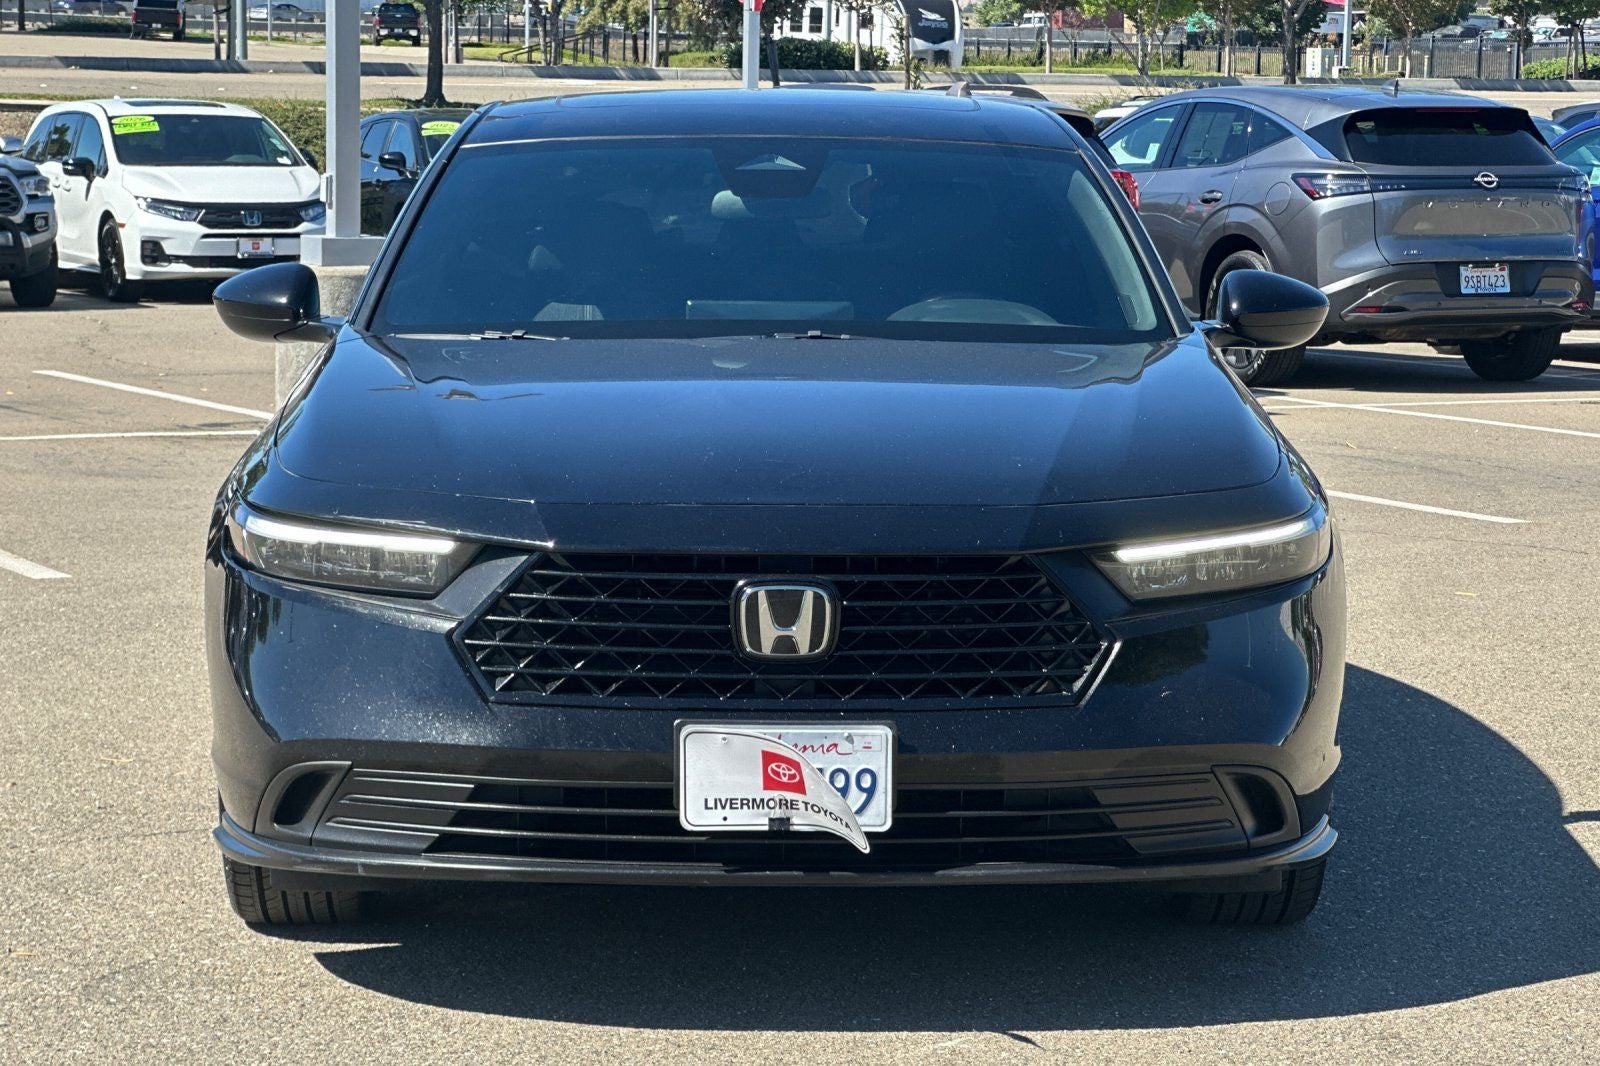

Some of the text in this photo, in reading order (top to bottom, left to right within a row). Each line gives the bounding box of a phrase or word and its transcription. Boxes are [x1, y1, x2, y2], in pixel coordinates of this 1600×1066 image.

[1422, 200, 1550, 209] MURANO
[1464, 275, 1506, 288] 9SBT423
[817, 767, 877, 815] 99
[704, 797, 853, 833] LIVERMORE TOYOTA
